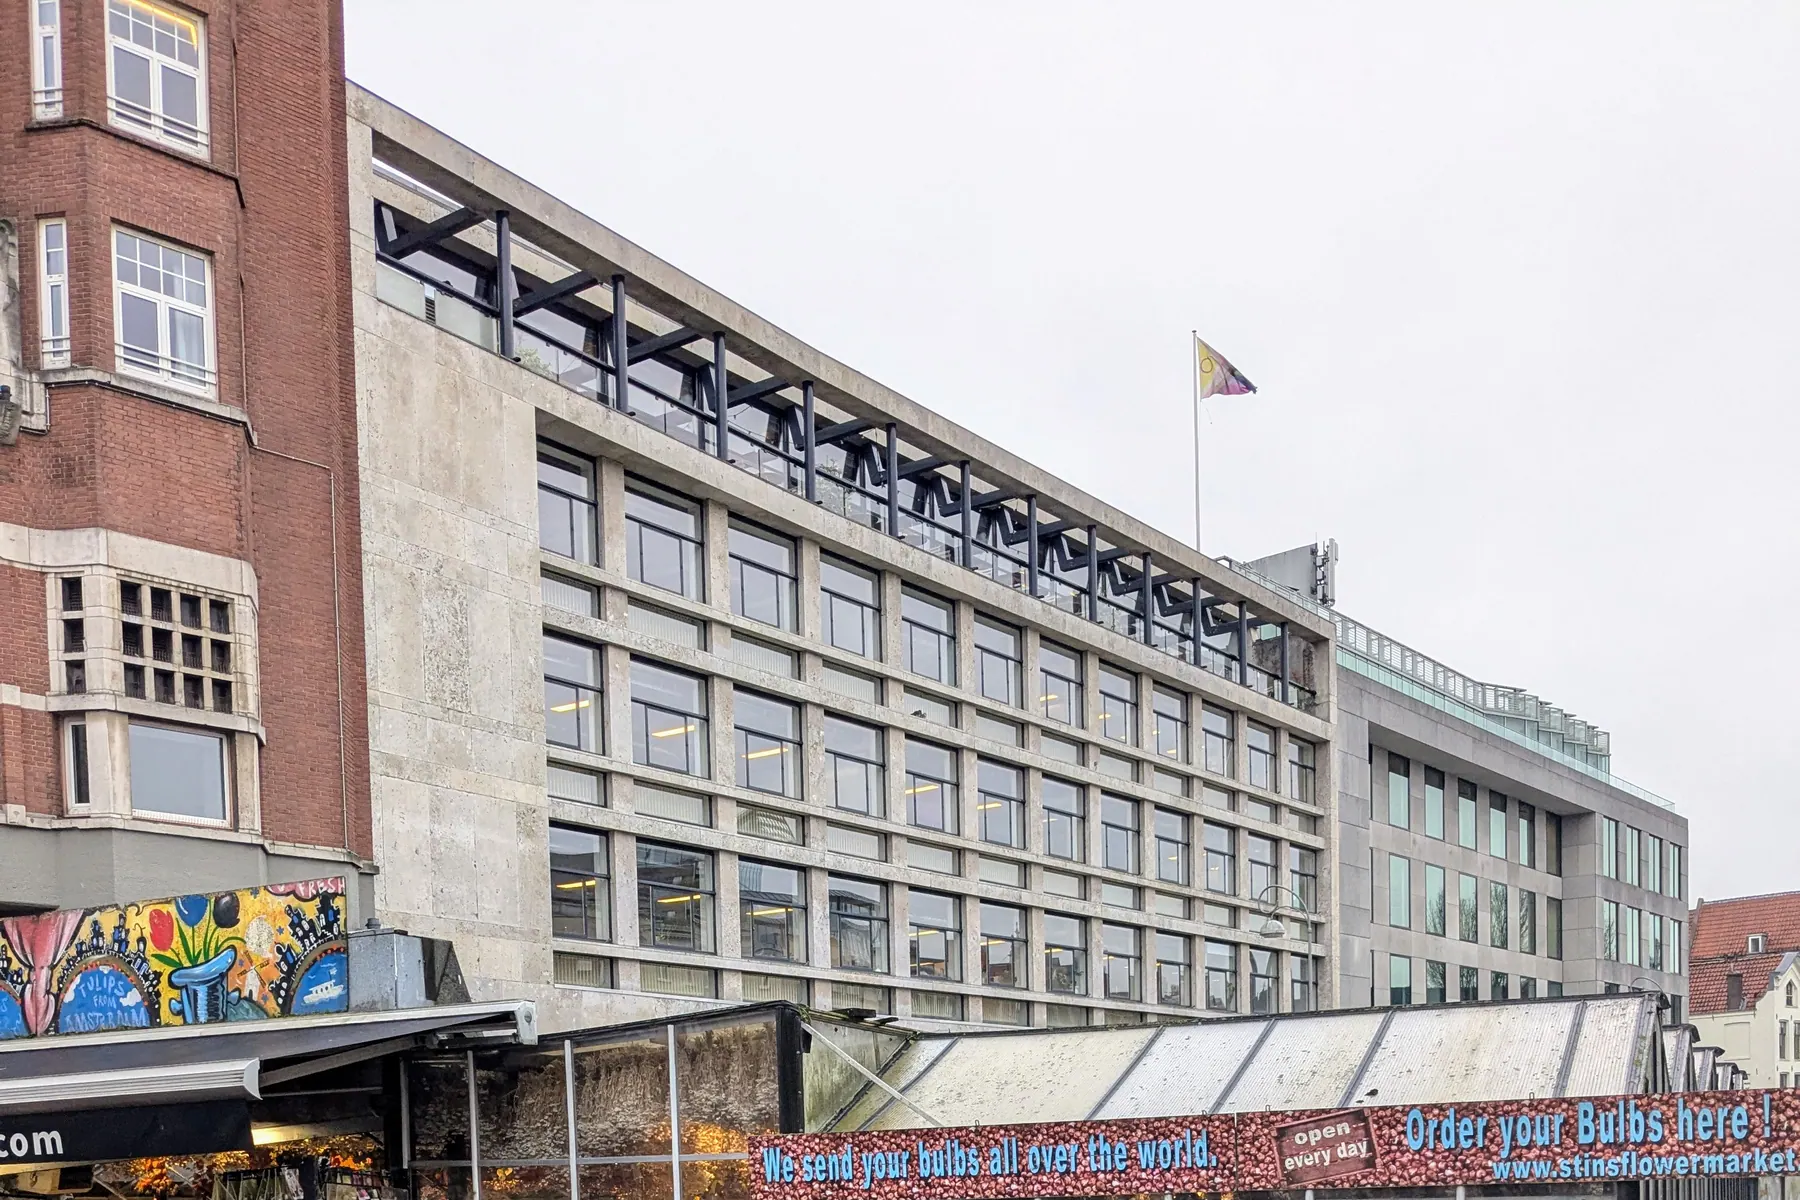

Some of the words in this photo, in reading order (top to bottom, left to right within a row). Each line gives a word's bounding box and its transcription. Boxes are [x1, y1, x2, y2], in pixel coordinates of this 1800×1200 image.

[77, 975, 126, 998] TULIPS
[93, 995, 117, 1009] FROM
[1294, 1123, 1350, 1146] open
[1406, 1109, 1487, 1152] Order
[1500, 1110, 1564, 1158] your
[1578, 1099, 1663, 1145] Bulbs
[1677, 1098, 1748, 1141] here
[763, 1146, 794, 1183] We
[803, 1144, 853, 1182] send
[862, 1149, 910, 1189] your
[919, 1140, 980, 1178] bulbs
[989, 1138, 1019, 1175] all
[1028, 1143, 1078, 1173] over
[1088, 1134, 1127, 1171] the
[1138, 1129, 1217, 1169] world.
[1284, 1147, 1334, 1171] every
[1337, 1140, 1368, 1163] day
